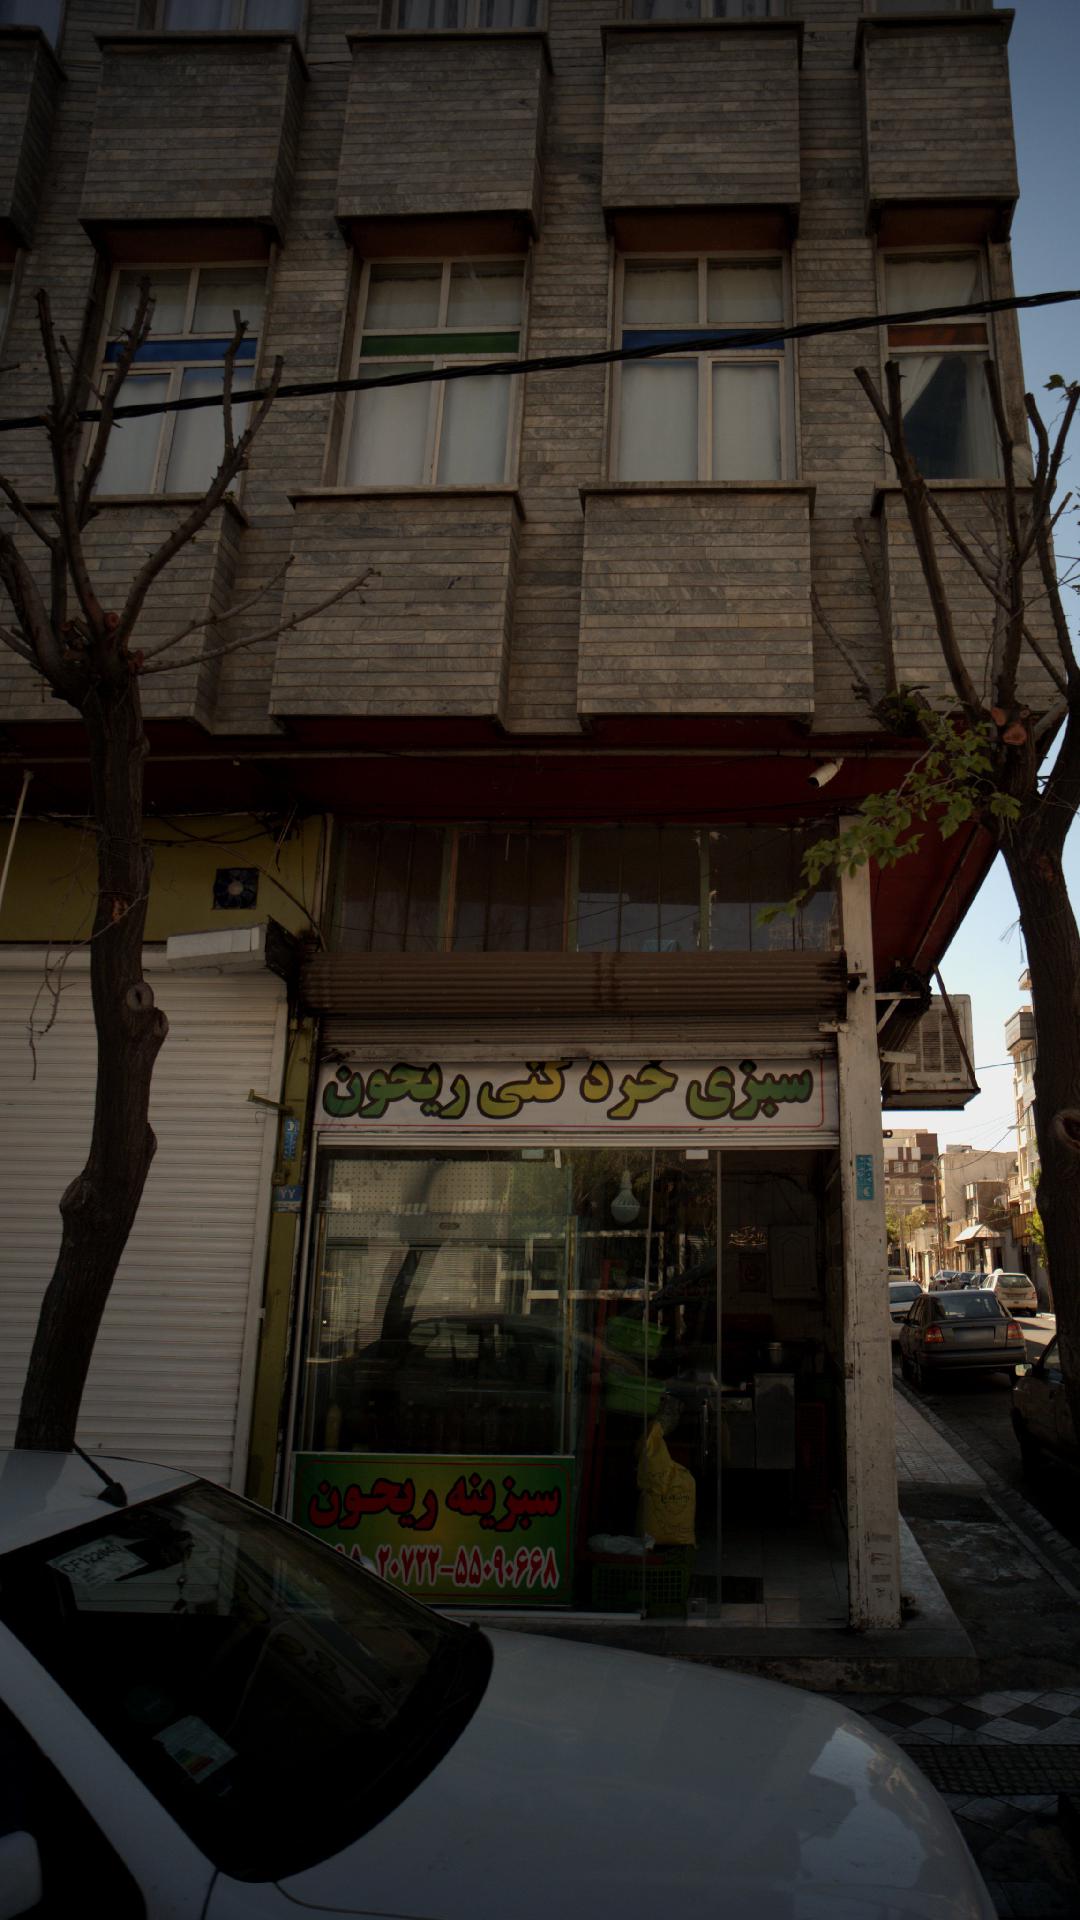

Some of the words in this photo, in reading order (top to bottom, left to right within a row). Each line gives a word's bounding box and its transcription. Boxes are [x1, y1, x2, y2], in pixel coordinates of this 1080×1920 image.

[323, 1062, 470, 1119] ریحون
[686, 1060, 813, 1120] سبزی
[308, 1477, 438, 1531] ریحون
[446, 1472, 561, 1532] سبزینه
